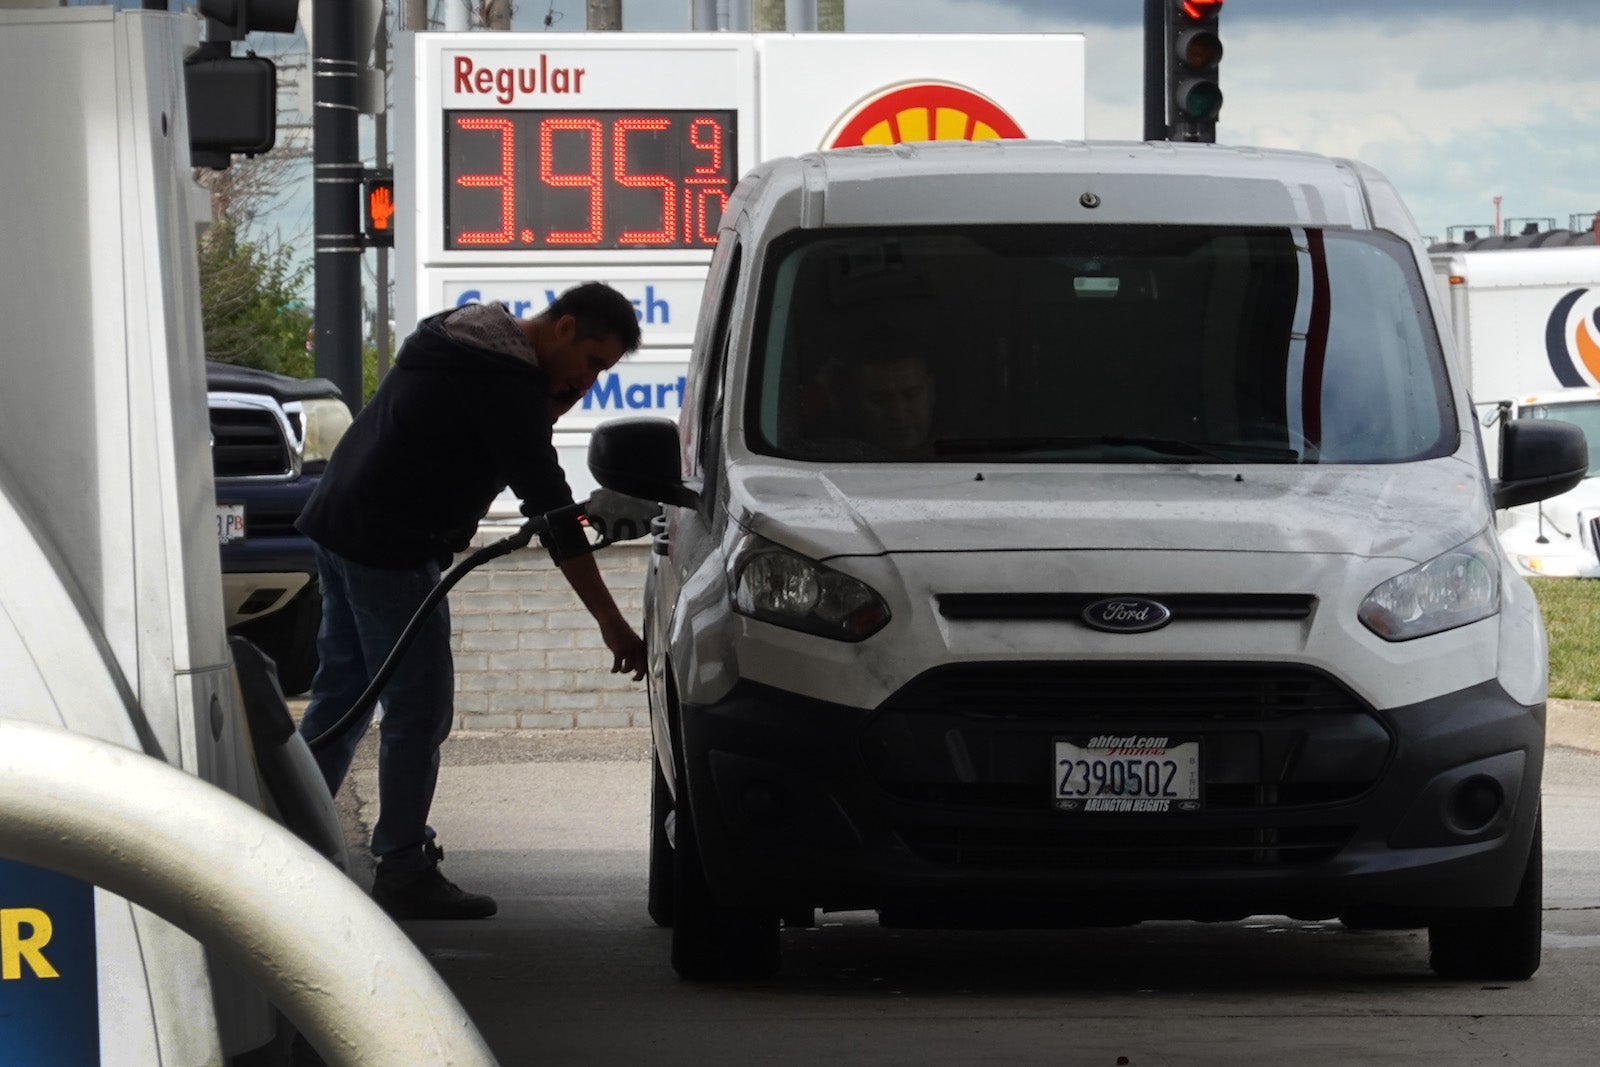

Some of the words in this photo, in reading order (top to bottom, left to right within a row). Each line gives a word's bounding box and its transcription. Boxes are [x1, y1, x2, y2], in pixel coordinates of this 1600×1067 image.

[454, 54, 586, 105] Regular
[456, 118, 676, 244] 3.95
[582, 373, 686, 410] Mart
[1102, 602, 1149, 620] Ford
[1087, 735, 1169, 749] ahford.com
[1058, 759, 1178, 797] 2390502
[1084, 799, 1133, 812] ARLINGTON
[1132, 800, 1171, 813] HEIGHTS
